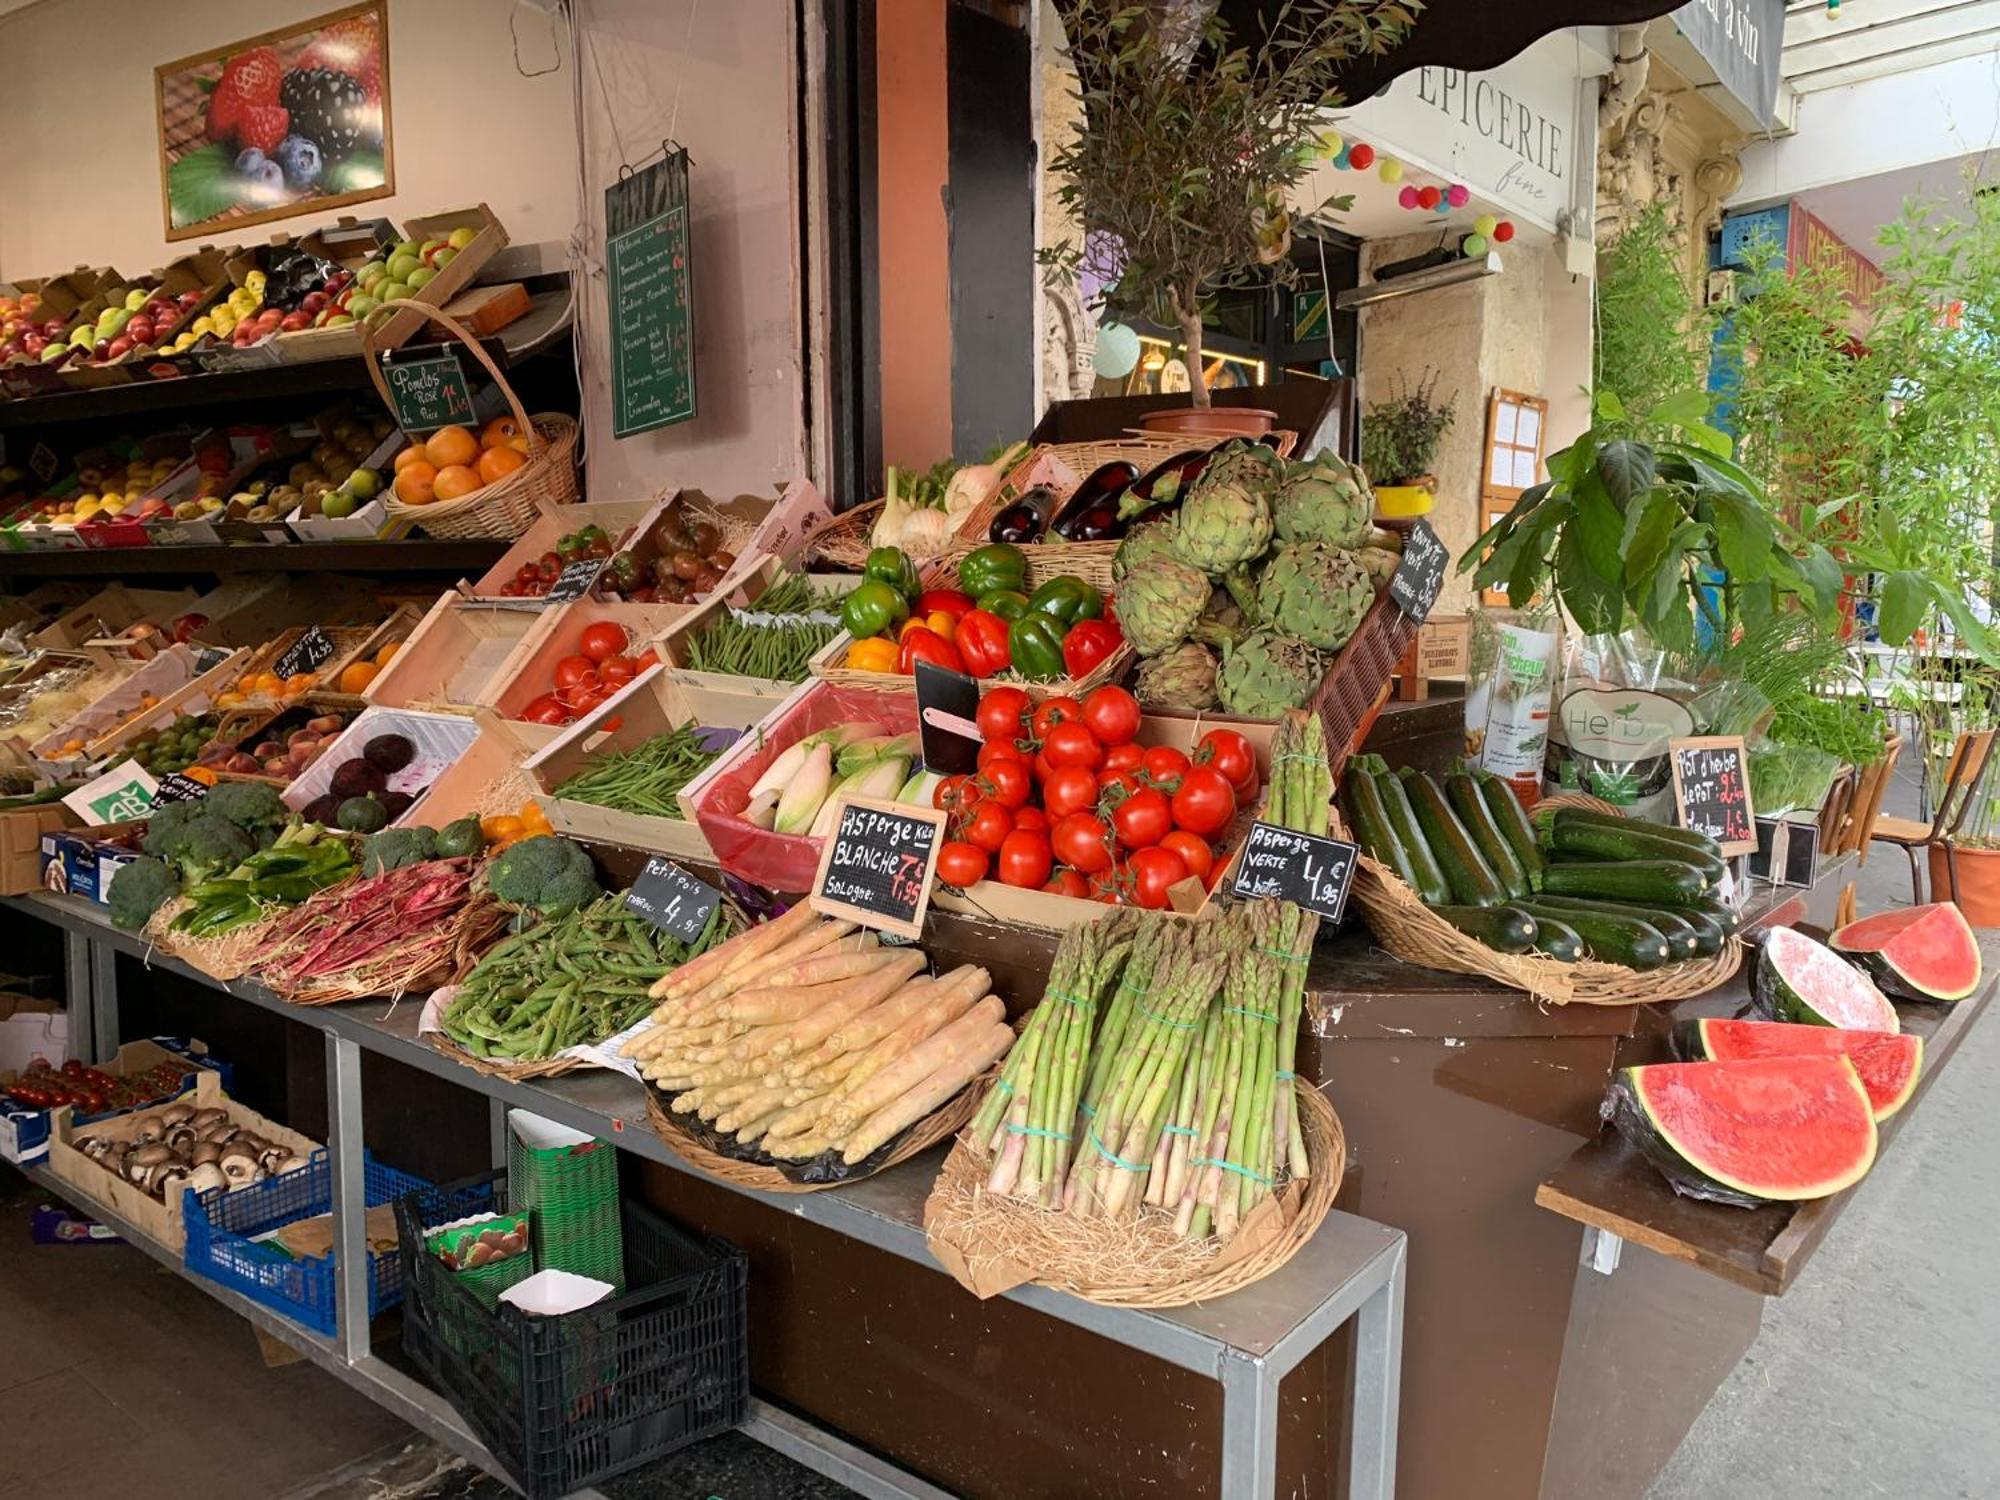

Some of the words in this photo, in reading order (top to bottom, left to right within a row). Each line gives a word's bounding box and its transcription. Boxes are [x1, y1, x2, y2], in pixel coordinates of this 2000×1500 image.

[1738, 4, 1758, 65] vin
[1496, 160, 1546, 199] fine
[166, 772, 208, 796] Tomate
[108, 796, 151, 823] AB
[645, 859, 677, 880] Petit
